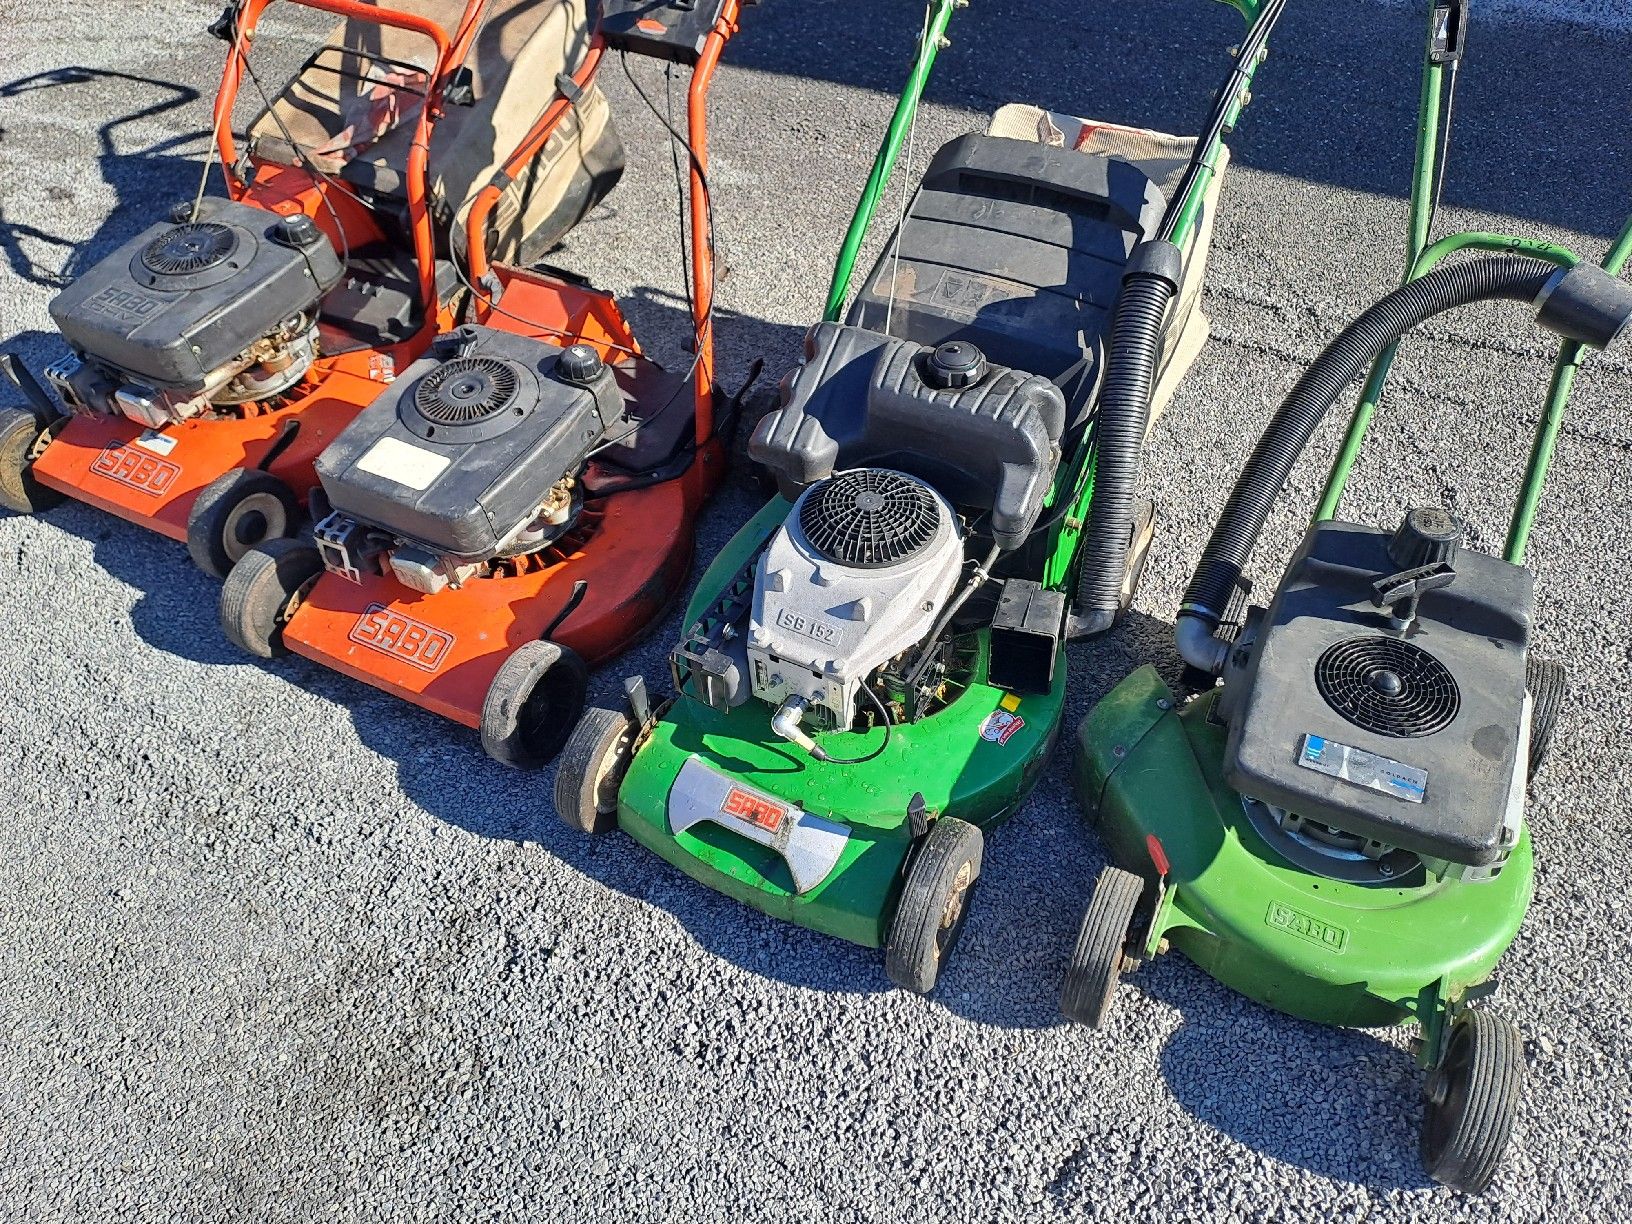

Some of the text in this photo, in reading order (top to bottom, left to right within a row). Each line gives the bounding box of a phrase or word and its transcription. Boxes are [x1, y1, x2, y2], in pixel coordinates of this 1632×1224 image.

[93, 287, 161, 316] SABO
[97, 445, 175, 491] SABO
[357, 611, 447, 665] SABO
[783, 613, 834, 642] SB 152
[725, 793, 782, 828] SABO
[1272, 904, 1343, 950] SABO
